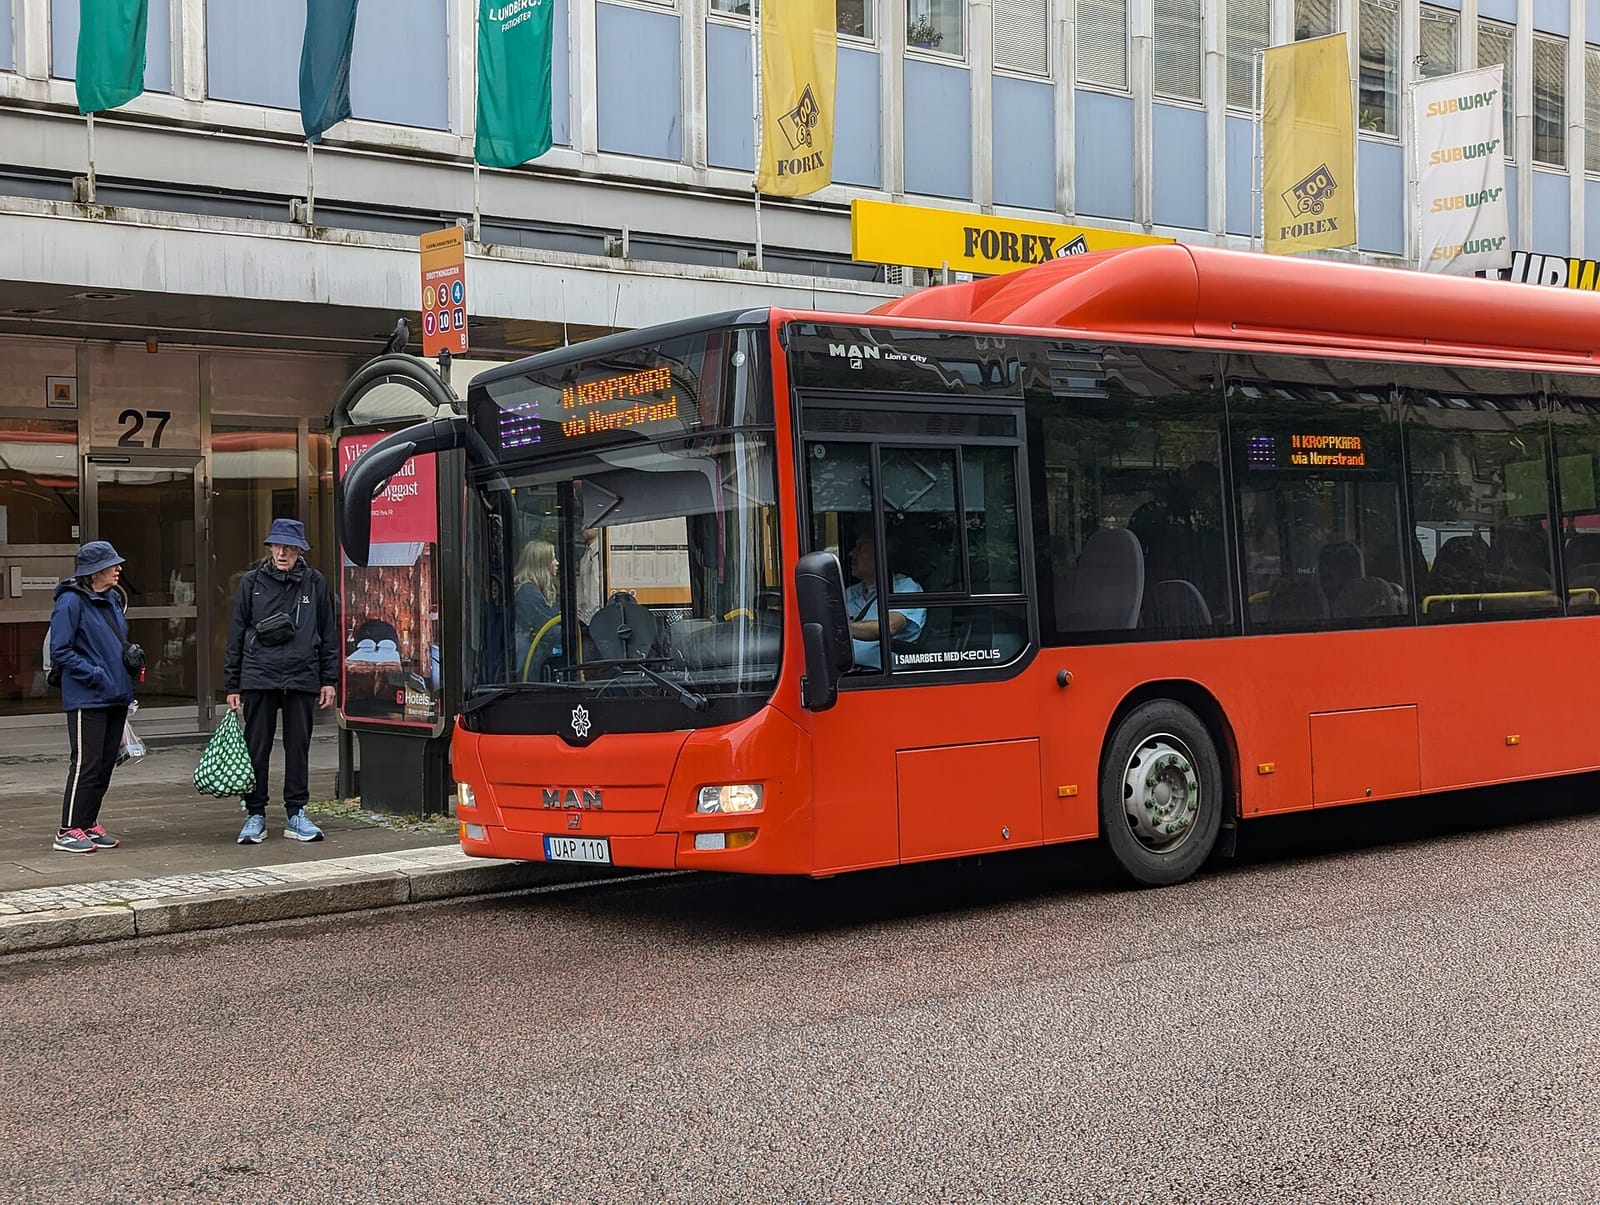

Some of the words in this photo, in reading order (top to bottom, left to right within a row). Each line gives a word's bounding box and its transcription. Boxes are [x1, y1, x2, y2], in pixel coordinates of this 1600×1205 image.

[1426, 89, 1498, 117] SUBWAY
[1428, 138, 1500, 167] SUBWAY
[1430, 187, 1503, 214] SUBWAY
[1280, 217, 1338, 240] FOREX
[963, 227, 1056, 265] FOREX
[1429, 235, 1506, 262] SUBWAY
[439, 313, 449, 329] 10
[454, 311, 463, 326] 11
[460, 333, 466, 345] B
[829, 343, 880, 359] MAN
[885, 353, 907, 361] Lion's
[910, 354, 927, 363] City
[563, 387, 574, 409] N
[562, 415, 586, 437] via
[589, 395, 678, 433] Norrstrand
[118, 409, 171, 448] 27
[1292, 435, 1300, 448] N
[1291, 451, 1308, 465] via
[1310, 452, 1365, 466] Norrstrand
[900, 652, 943, 665] SAMARBETE
[944, 651, 960, 662] MED
[405, 691, 436, 706] Hotels
[542, 787, 604, 809] MAN
[553, 839, 577, 859] UAP
[581, 841, 604, 860] 110
